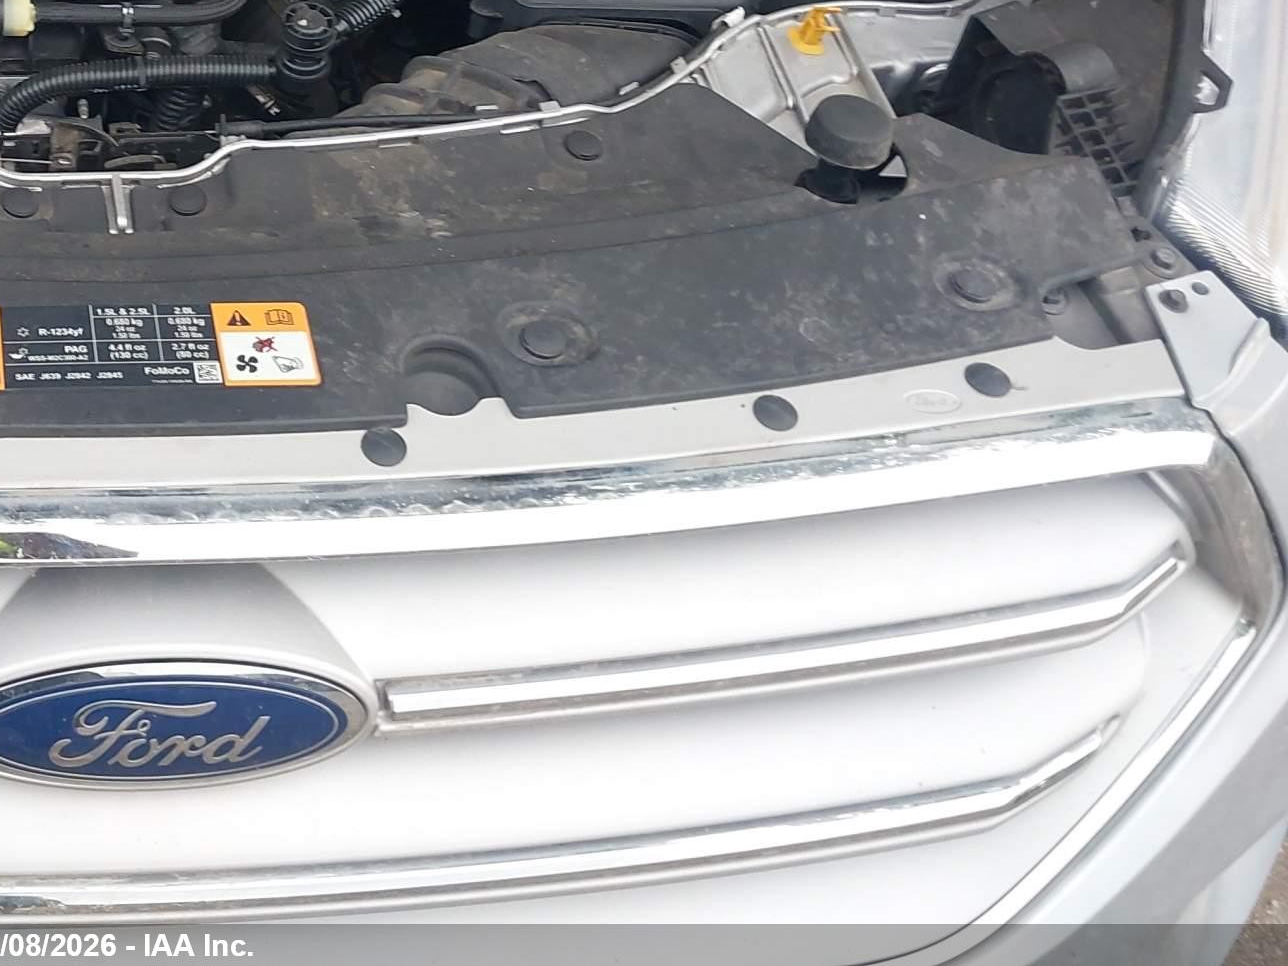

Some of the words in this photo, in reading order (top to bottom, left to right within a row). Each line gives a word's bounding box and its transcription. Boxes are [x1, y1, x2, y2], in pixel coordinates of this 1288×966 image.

[96, 308, 118, 316] 1.5L
[118, 307, 128, 315] &
[128, 307, 152, 315] 2.5L
[173, 306, 197, 314] 2.0L
[131, 318, 144, 327] kg
[193, 317, 206, 326] kg
[37, 327, 84, 337] R-1234yf
[63, 344, 89, 354] PAG
[171, 342, 187, 351] 2.7
[109, 351, 132, 361] (130
[132, 351, 149, 360] cc)
[193, 350, 210, 360] cc)
[143, 366, 190, 375] FoMoCo
[14, 373, 36, 381] SAE
[47, 699, 270, 768] Ford
